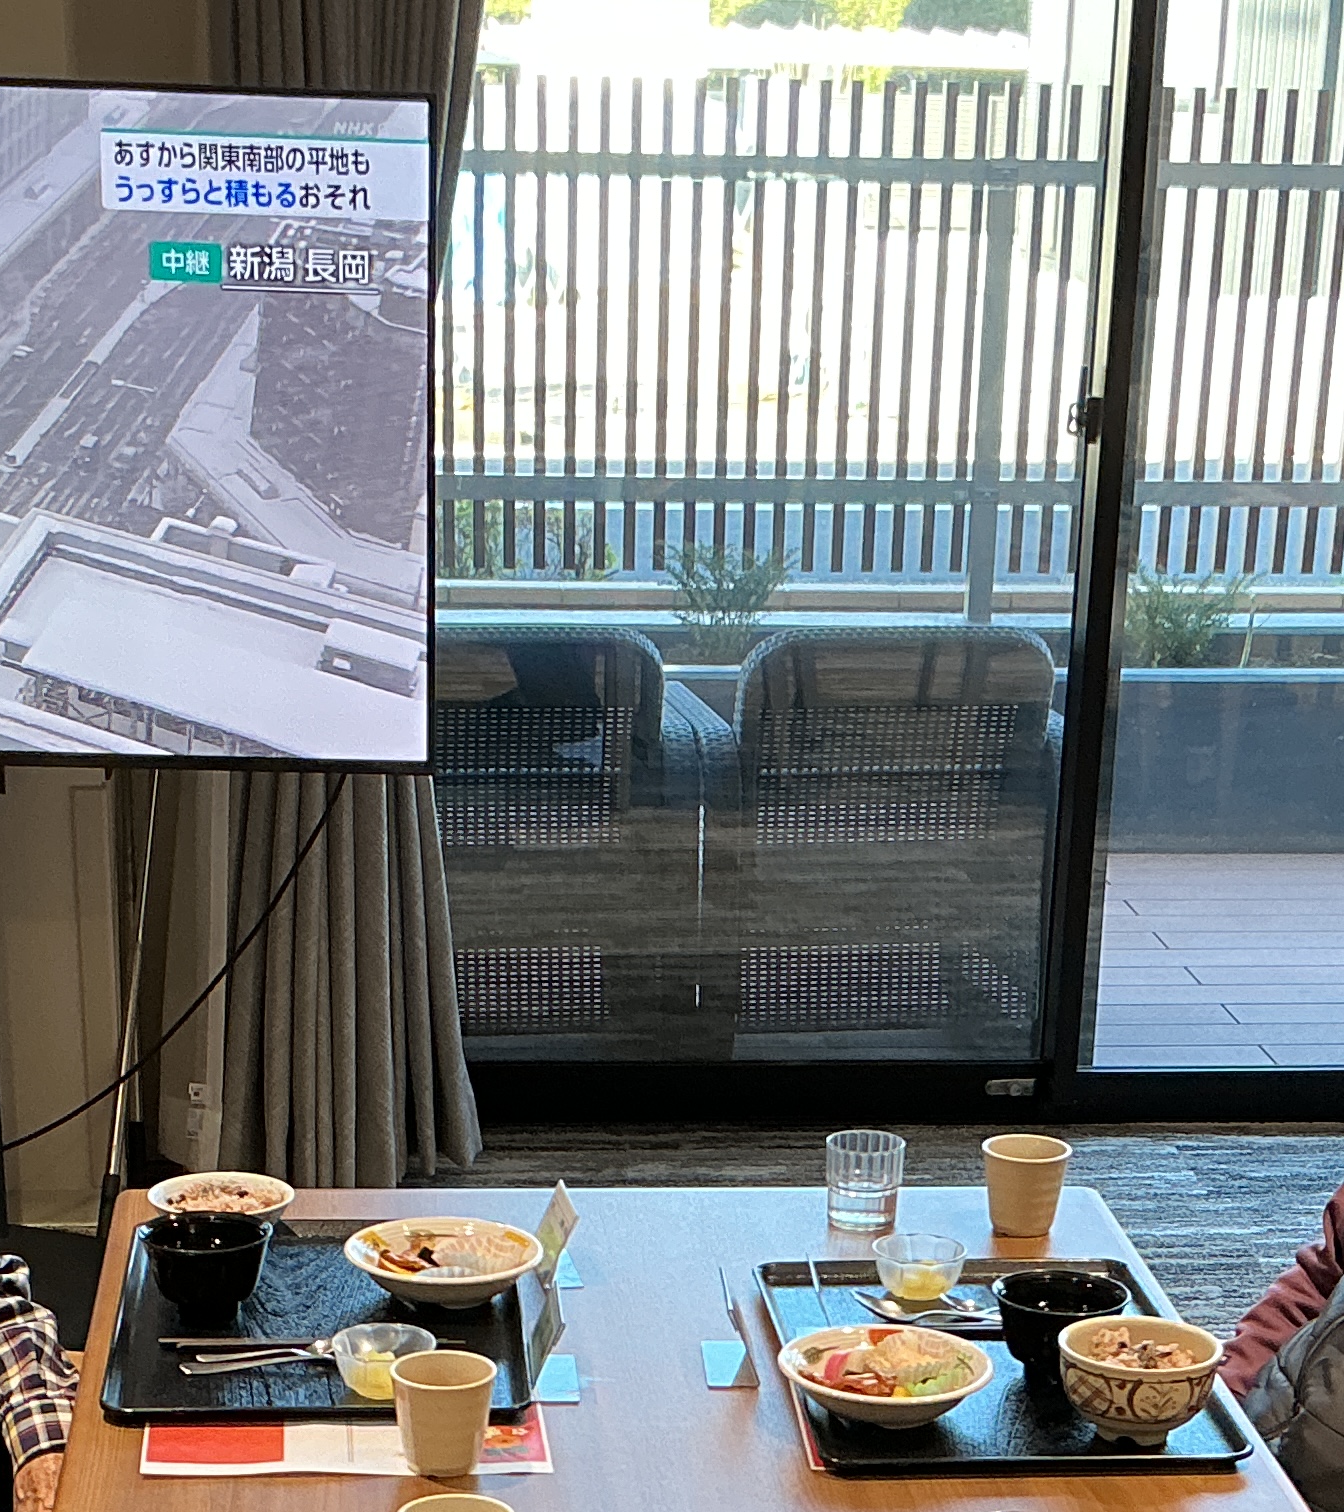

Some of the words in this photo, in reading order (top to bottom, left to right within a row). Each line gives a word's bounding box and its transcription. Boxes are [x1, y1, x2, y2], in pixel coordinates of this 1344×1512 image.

[333, 121, 375, 136] NHK
[114, 139, 370, 176] あすから関東南部の平地も
[114, 176, 371, 211] うっすらと積もるおそれ
[161, 251, 210, 276] 中継
[229, 246, 295, 282] 新潟
[304, 249, 369, 285] 長岡
